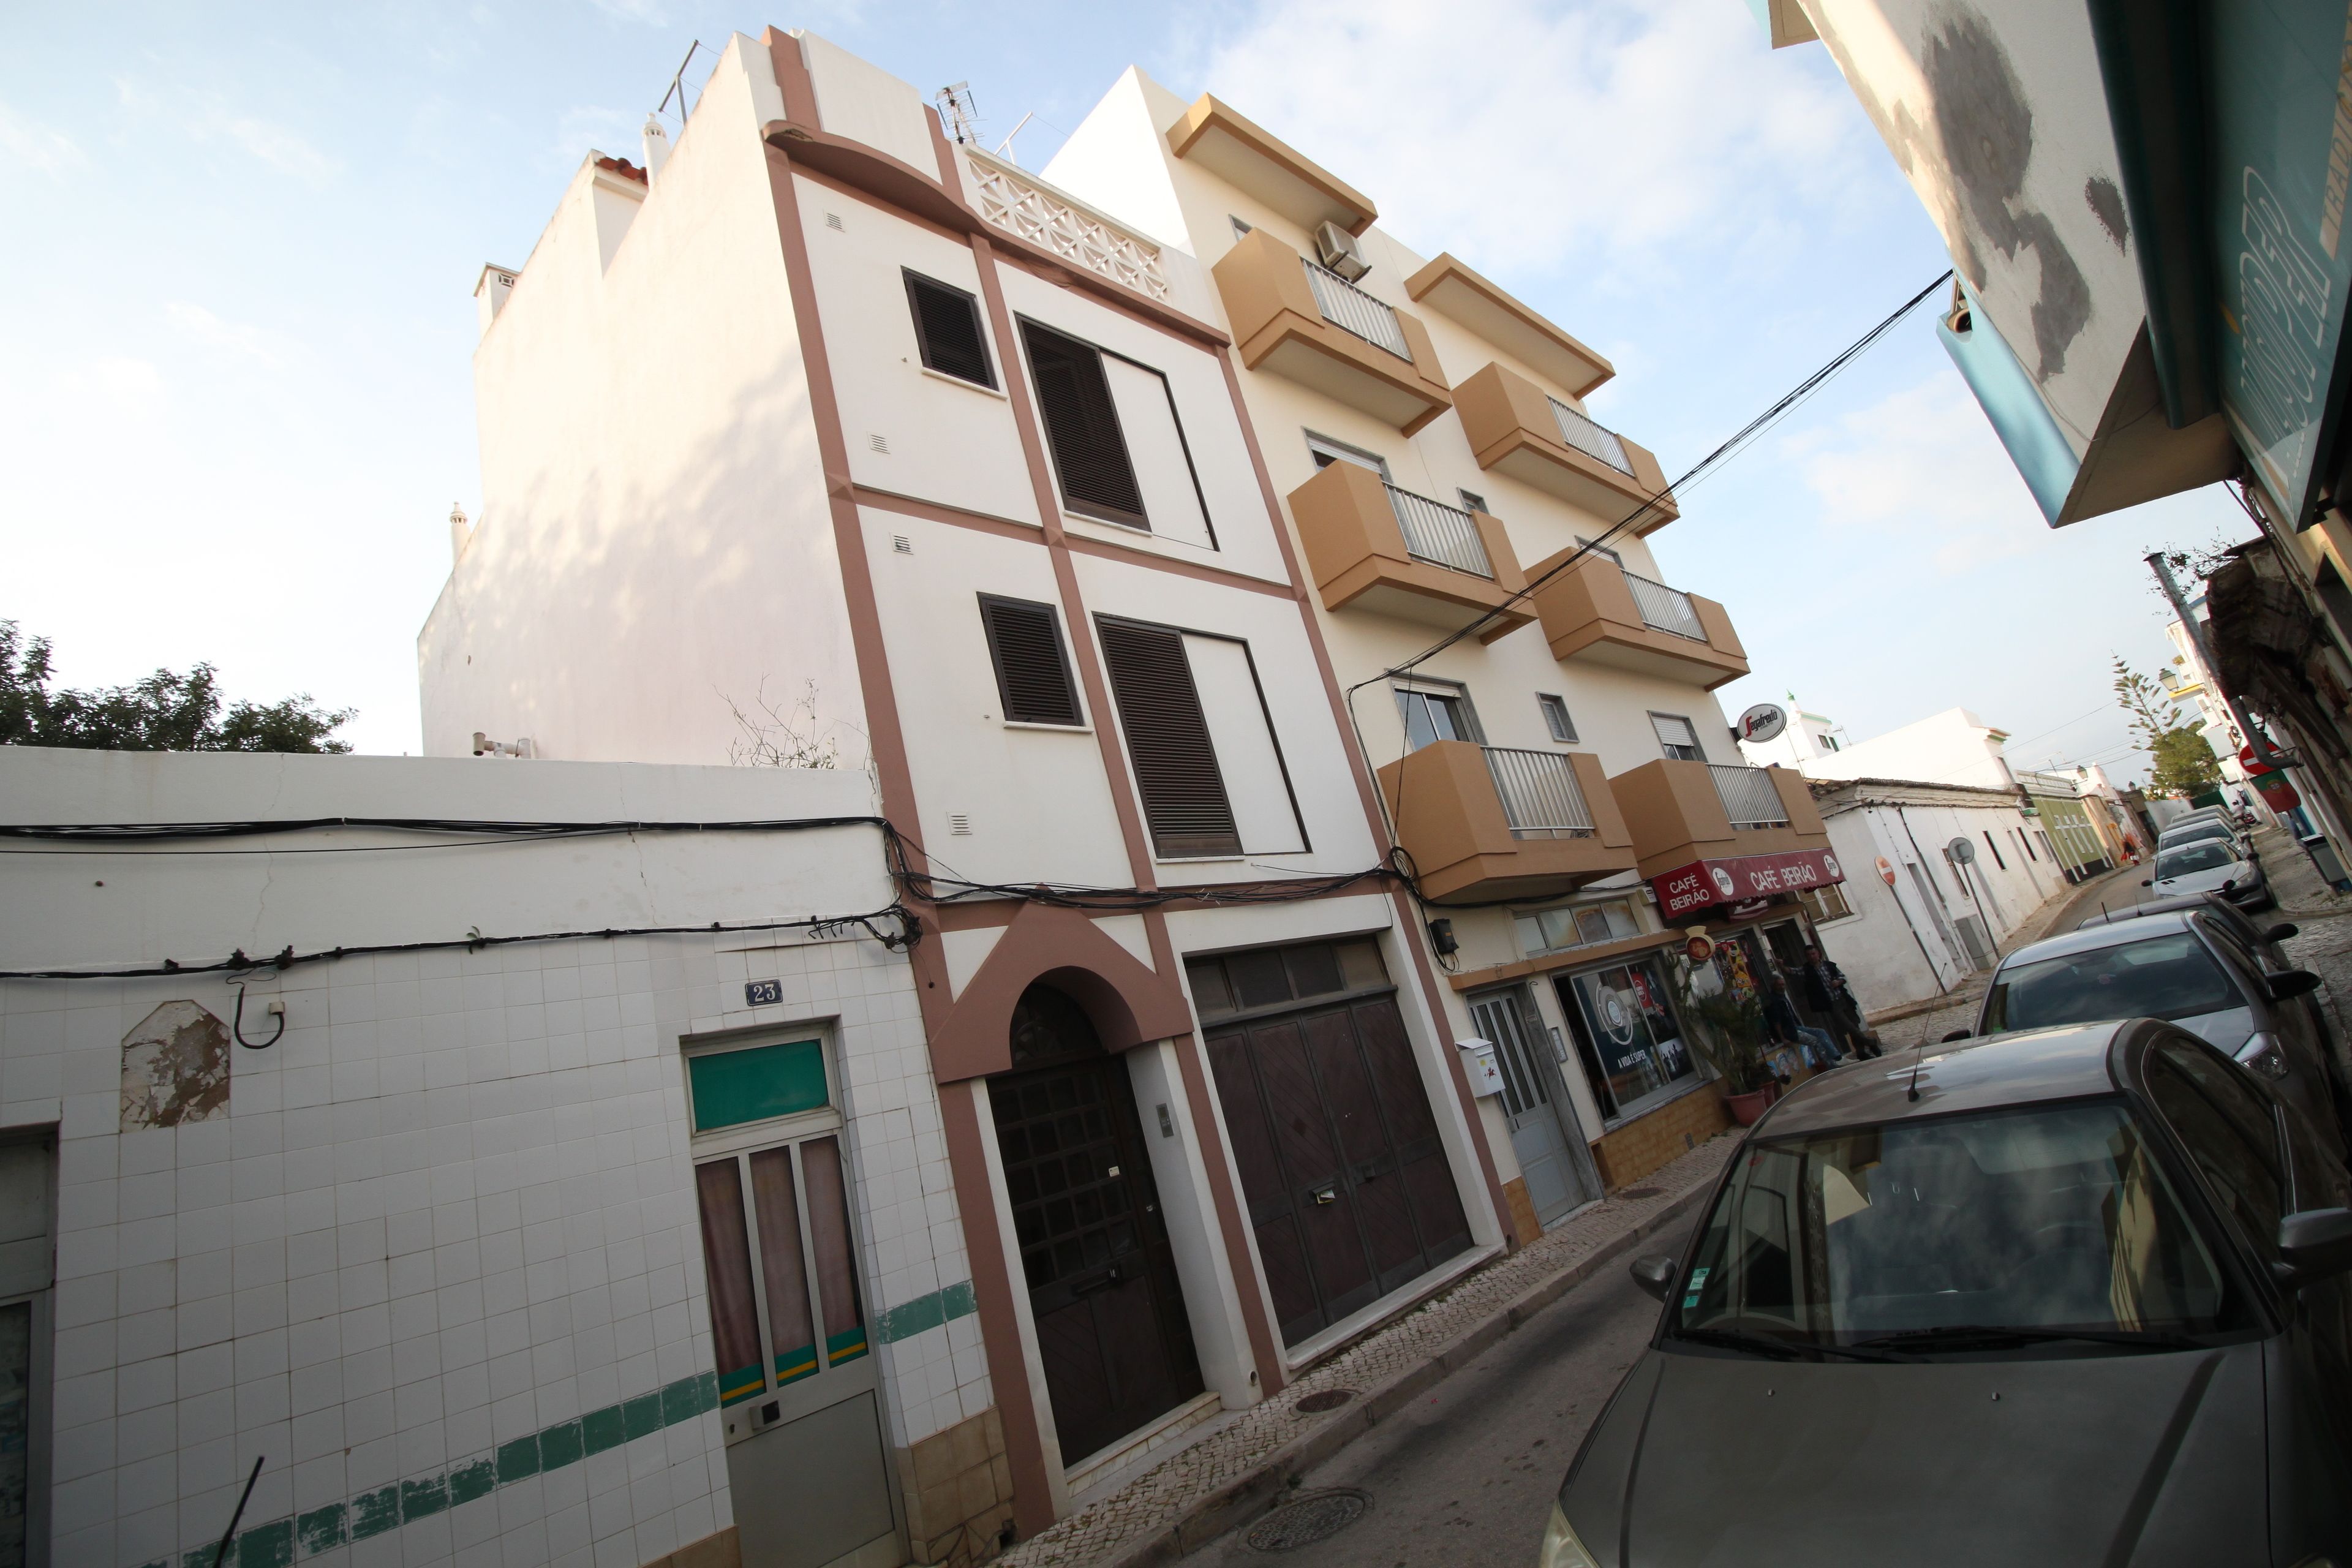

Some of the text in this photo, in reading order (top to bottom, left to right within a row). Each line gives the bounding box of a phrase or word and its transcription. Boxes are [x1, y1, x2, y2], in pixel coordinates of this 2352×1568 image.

[1745, 709, 1778, 737] Segafredo
[1669, 873, 1699, 894] CAFÉ
[1749, 865, 1781, 891] CAFÉ
[1781, 862, 1817, 887] BEIRÃO
[1670, 888, 1710, 911] BEIRÃO
[754, 983, 776, 1002] 23
[1618, 1058, 1623, 1069] A
